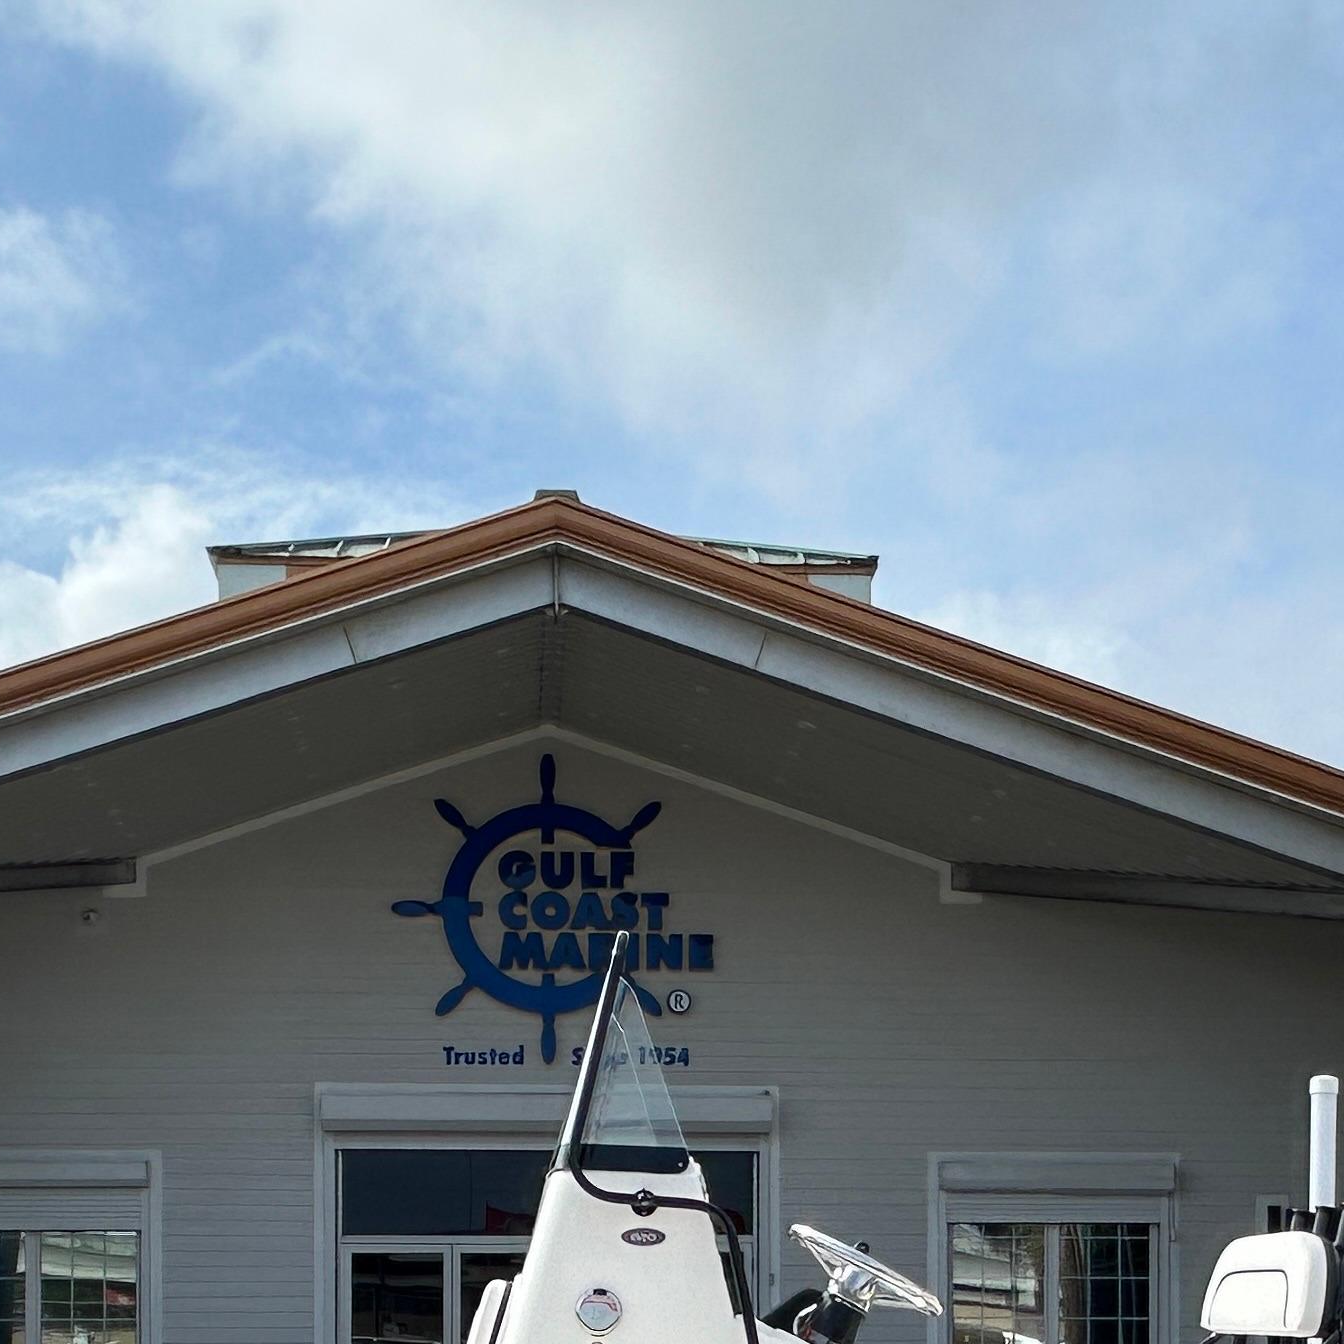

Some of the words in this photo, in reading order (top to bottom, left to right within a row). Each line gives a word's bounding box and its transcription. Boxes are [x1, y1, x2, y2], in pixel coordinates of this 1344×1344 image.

[498, 850, 635, 889] GULF
[498, 891, 670, 931] COAST
[443, 1045, 525, 1067] Trusted
